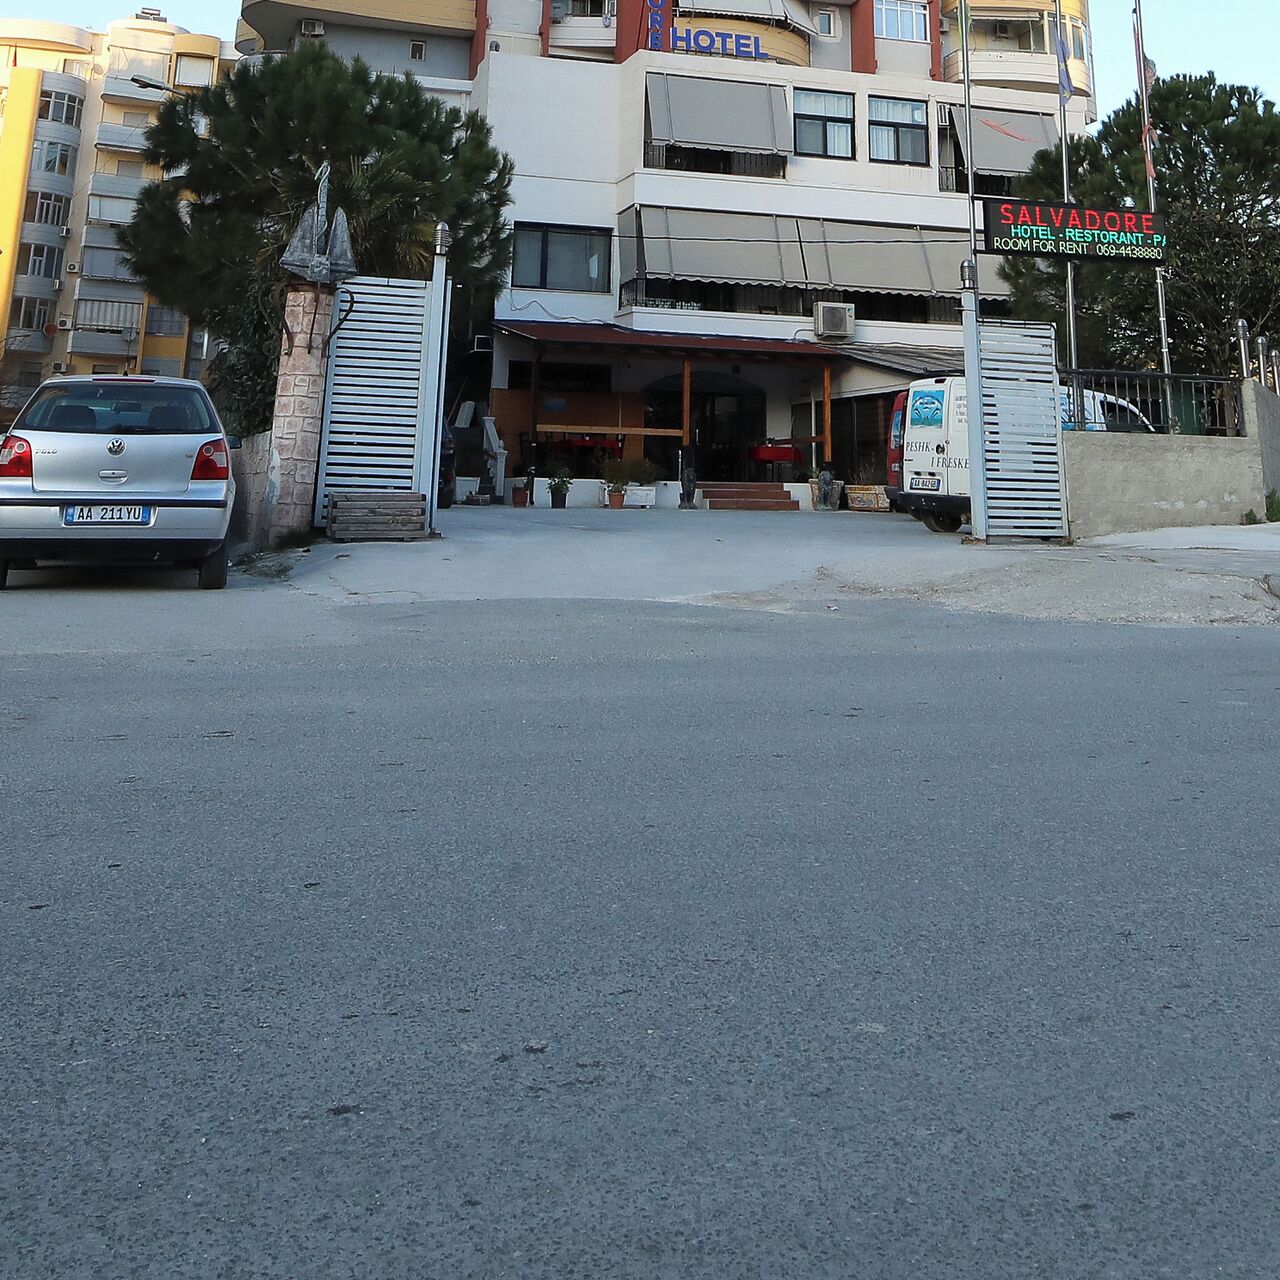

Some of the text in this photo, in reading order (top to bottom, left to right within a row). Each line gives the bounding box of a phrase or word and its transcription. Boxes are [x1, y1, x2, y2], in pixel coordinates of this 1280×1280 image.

[670, 26, 769, 59] HOTEL
[1000, 203, 1155, 234] SALVADORE
[1011, 224, 1056, 240] HOTEL
[1065, 228, 1144, 245] RESTORANT
[994, 237, 1031, 252] ROOM
[1033, 239, 1057, 253] FOR
[1059, 241, 1089, 255] RENT
[77, 507, 93, 520] AA
